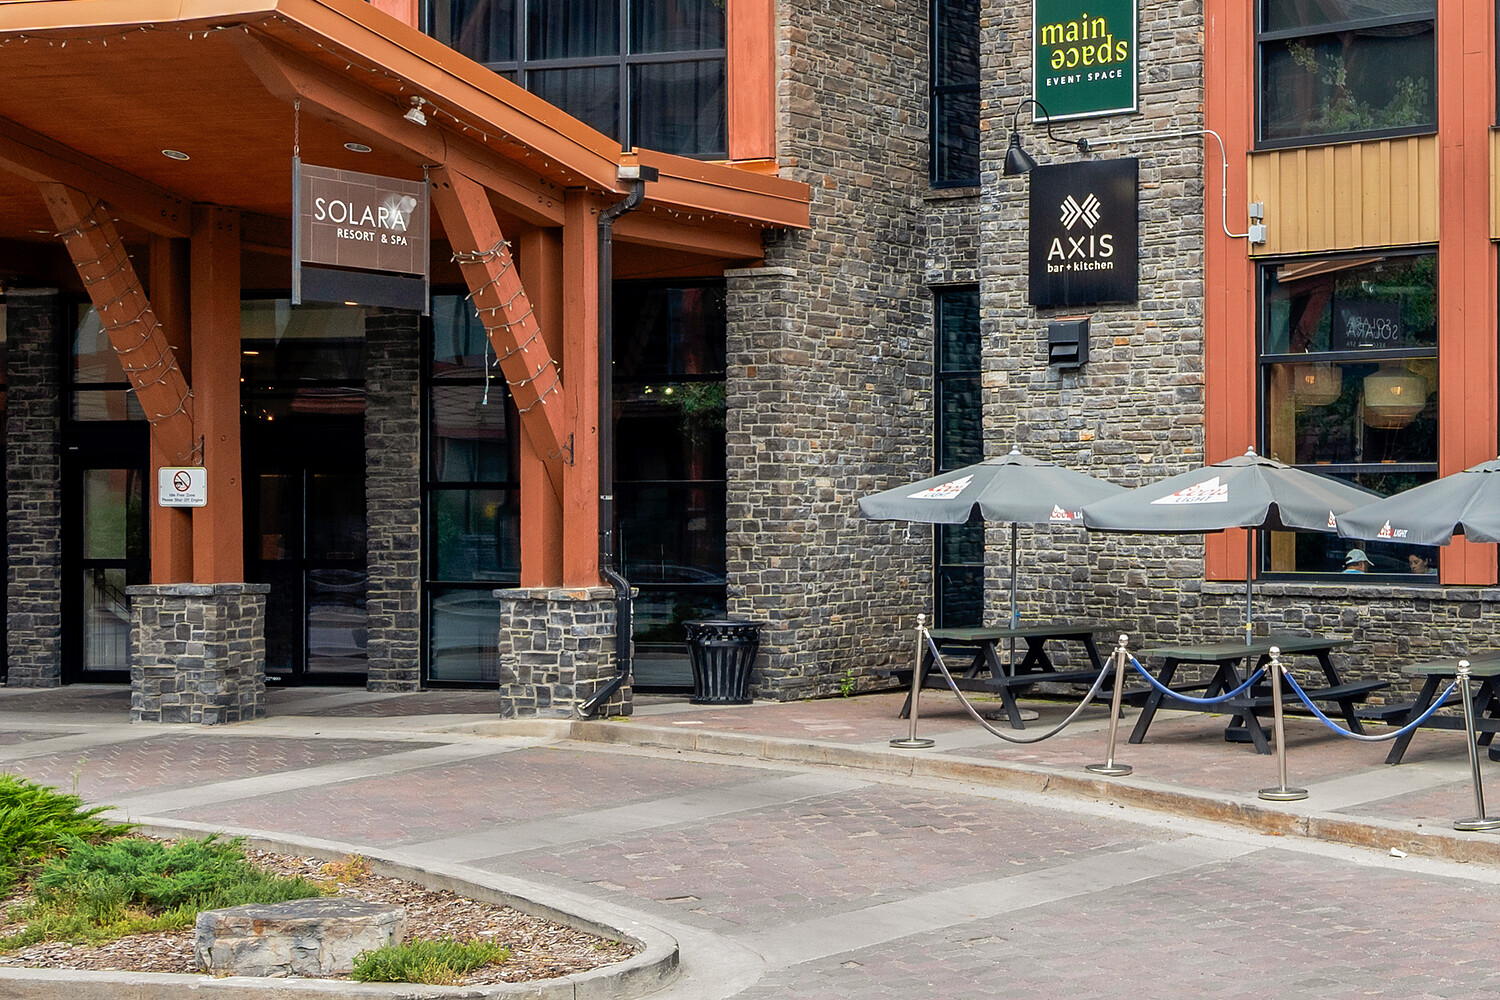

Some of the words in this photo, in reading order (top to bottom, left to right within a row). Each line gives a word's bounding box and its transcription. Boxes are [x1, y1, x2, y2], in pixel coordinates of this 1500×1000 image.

[1041, 13, 1106, 45] main
[1046, 75, 1081, 86] EVENT
[1087, 69, 1123, 81] SPACE
[314, 197, 407, 231] SOLARA
[337, 228, 375, 241] RESORT
[381, 233, 388, 244] &
[390, 235, 408, 246] SPA
[1047, 234, 1114, 260] AXIS
[1047, 263, 1064, 273] bar
[1073, 260, 1114, 271] kitchen
